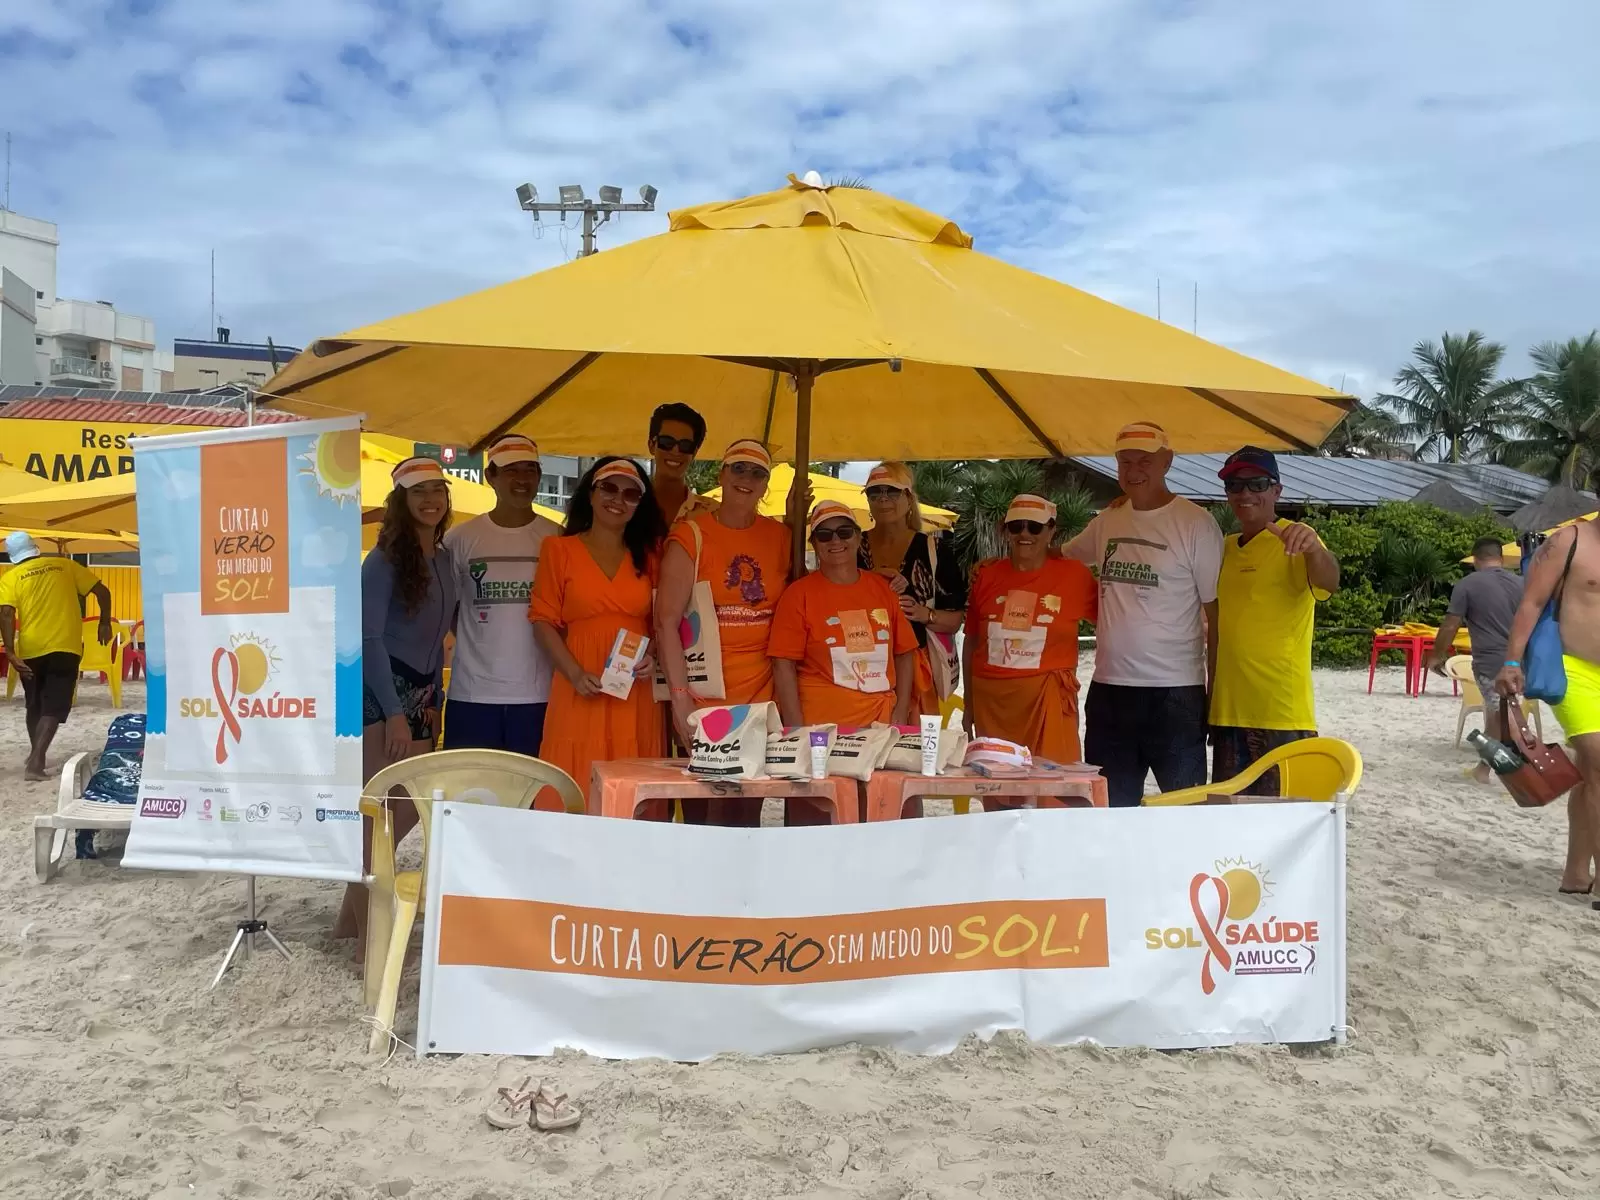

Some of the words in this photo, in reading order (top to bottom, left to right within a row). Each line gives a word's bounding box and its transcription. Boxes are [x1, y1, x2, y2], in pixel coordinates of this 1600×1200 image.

[219, 506, 259, 533] CURTA
[213, 531, 275, 555] VERÃO
[217, 559, 234, 576] SEM
[235, 557, 258, 575] MEDO
[260, 556, 272, 573] DO
[1108, 569, 1159, 581] PREVENIR
[1110, 561, 1152, 572] EDUCAR
[214, 576, 275, 602] SOL!
[180, 698, 219, 718] SOL
[237, 691, 317, 718] SAÚDE
[924, 735, 937, 750] 75
[143, 799, 180, 812] AMUCC
[551, 914, 642, 971] CURTA
[654, 933, 668, 968] O
[672, 931, 825, 974] VERÃO
[827, 932, 864, 965] SEM
[871, 927, 921, 961] MEDO
[929, 924, 953, 956] DO
[955, 912, 1089, 960] SOL!
[1144, 927, 1202, 950] SOL
[1225, 915, 1320, 945] SAÚDE
[1235, 949, 1298, 966] AMUCC
